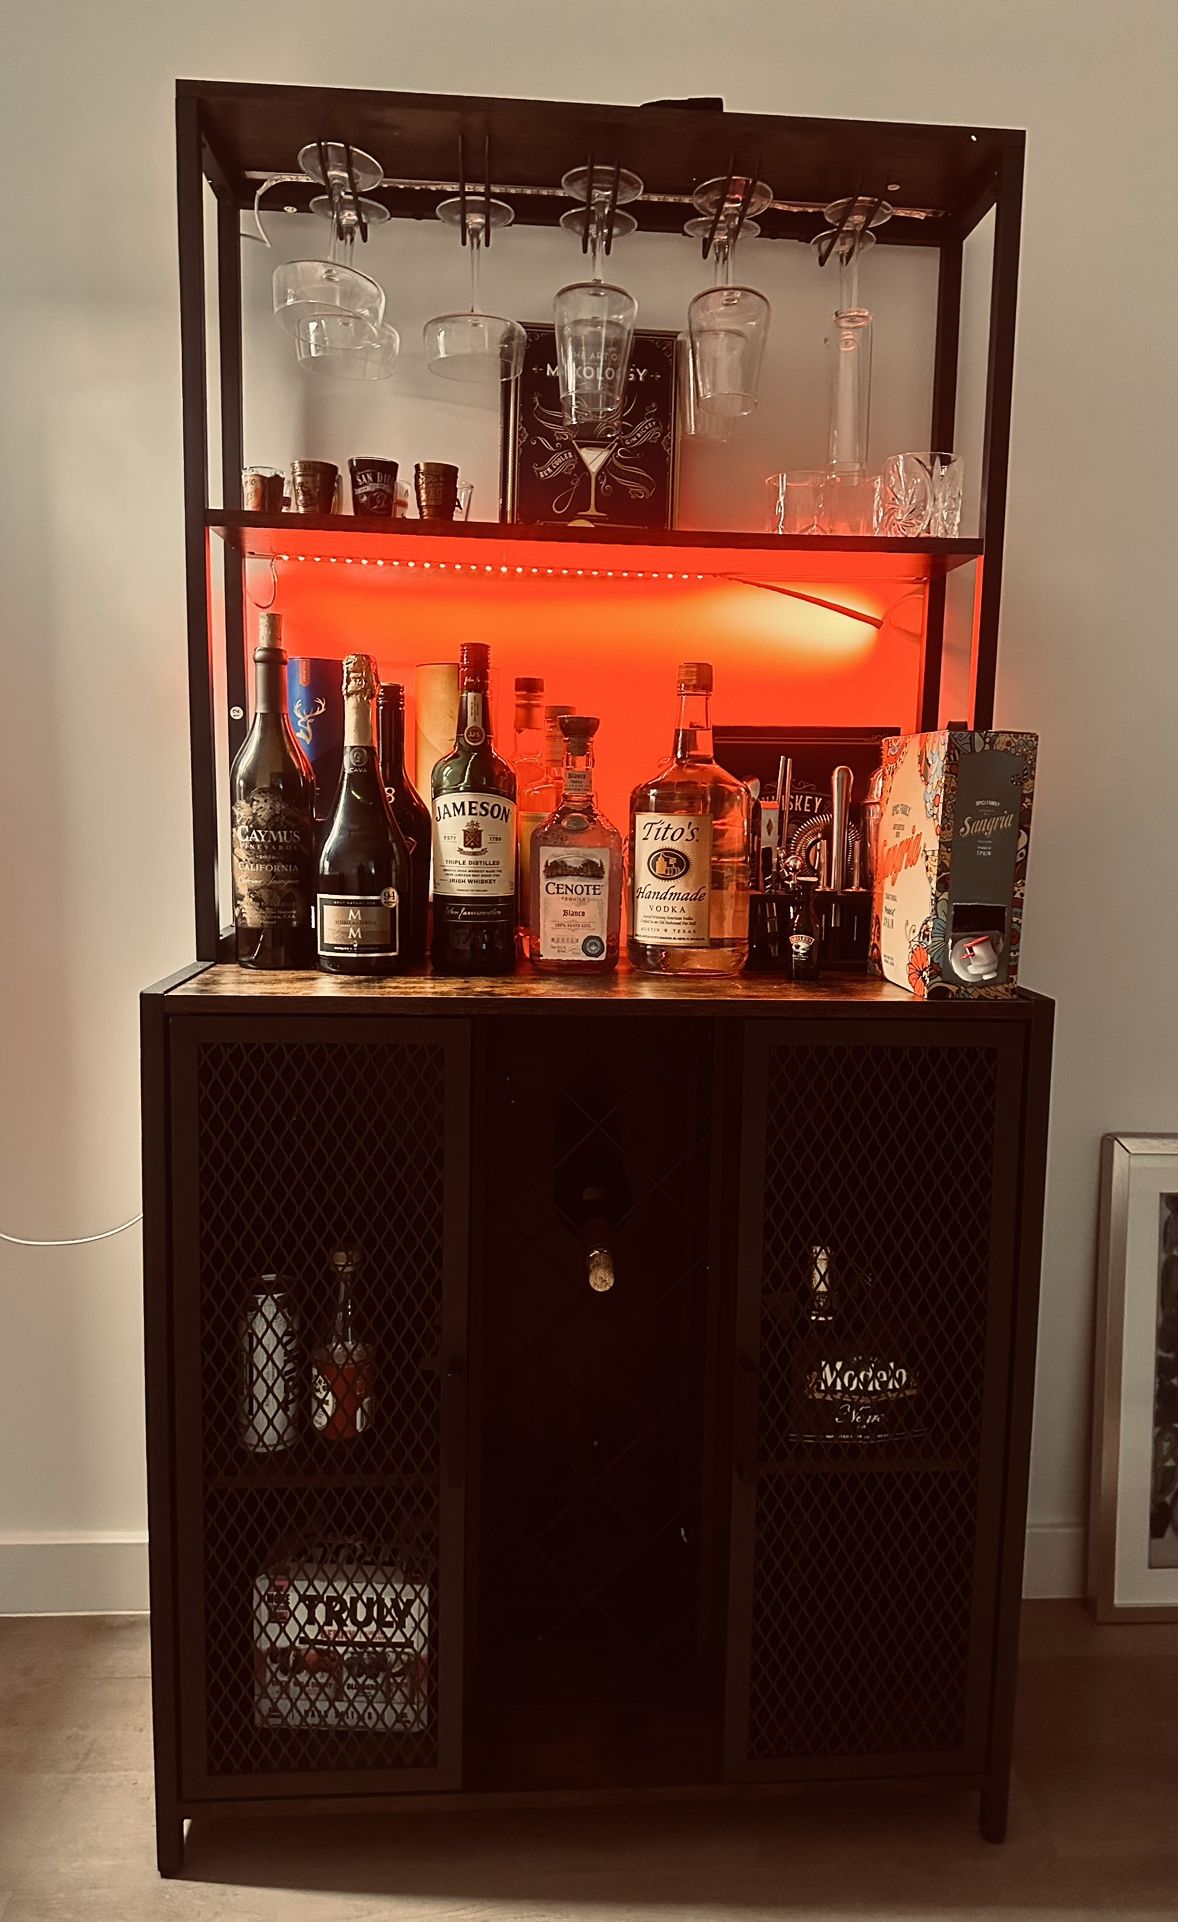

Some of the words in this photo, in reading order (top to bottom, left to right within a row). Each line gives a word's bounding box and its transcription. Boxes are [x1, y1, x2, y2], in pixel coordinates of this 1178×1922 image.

[546, 363, 647, 381] MXOLOGY
[356, 472, 373, 486] SAN
[435, 800, 512, 823] JAMESON
[959, 810, 1014, 837] Sangria
[237, 825, 301, 843] CAYMUS
[238, 861, 299, 872] CALIFORNIA
[545, 881, 602, 896] CENOTE
[635, 883, 707, 902] Handmade
[348, 908, 362, 921] M
[562, 909, 586, 917] Blanco
[649, 904, 686, 914] VODKA
[348, 927, 362, 939] M
[820, 1361, 908, 1392] Modelo
[299, 1594, 415, 1629] TRULY
